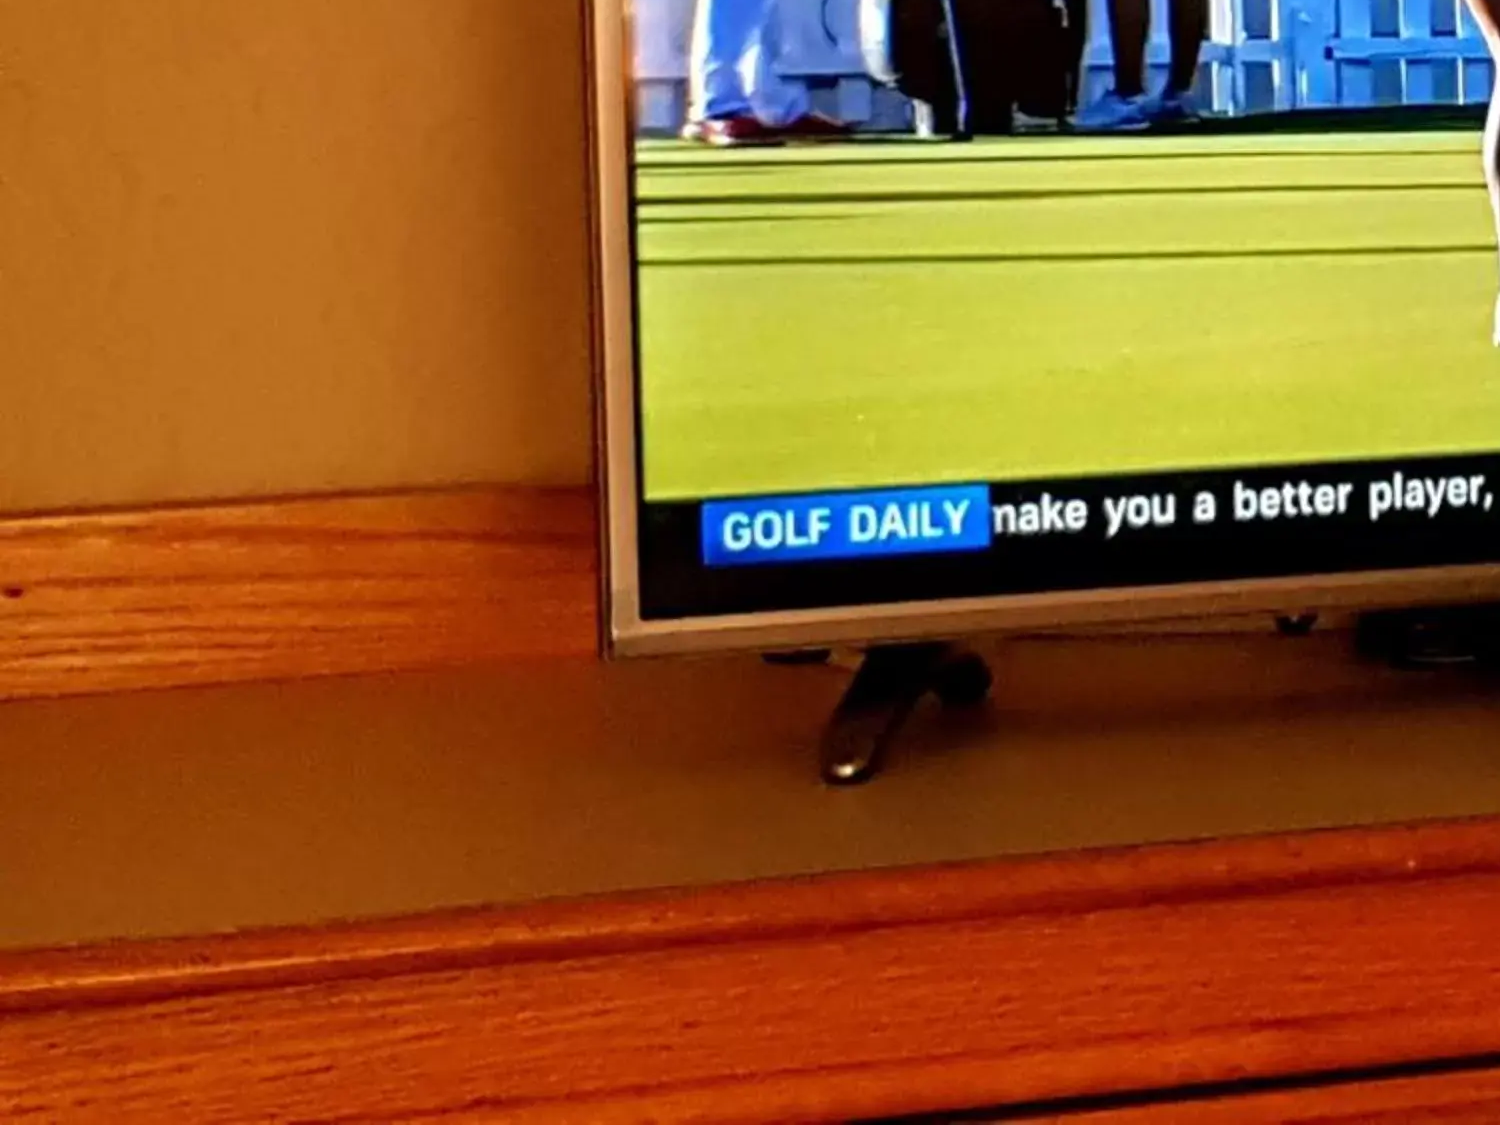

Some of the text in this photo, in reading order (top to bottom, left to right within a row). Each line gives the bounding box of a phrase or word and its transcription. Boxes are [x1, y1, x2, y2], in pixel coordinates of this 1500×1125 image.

[723, 500, 969, 551] GOLF DAILY
[1103, 493, 1176, 538] you
[1192, 490, 1217, 523] a
[1233, 480, 1354, 521] better
[1368, 470, 1493, 521] player,
